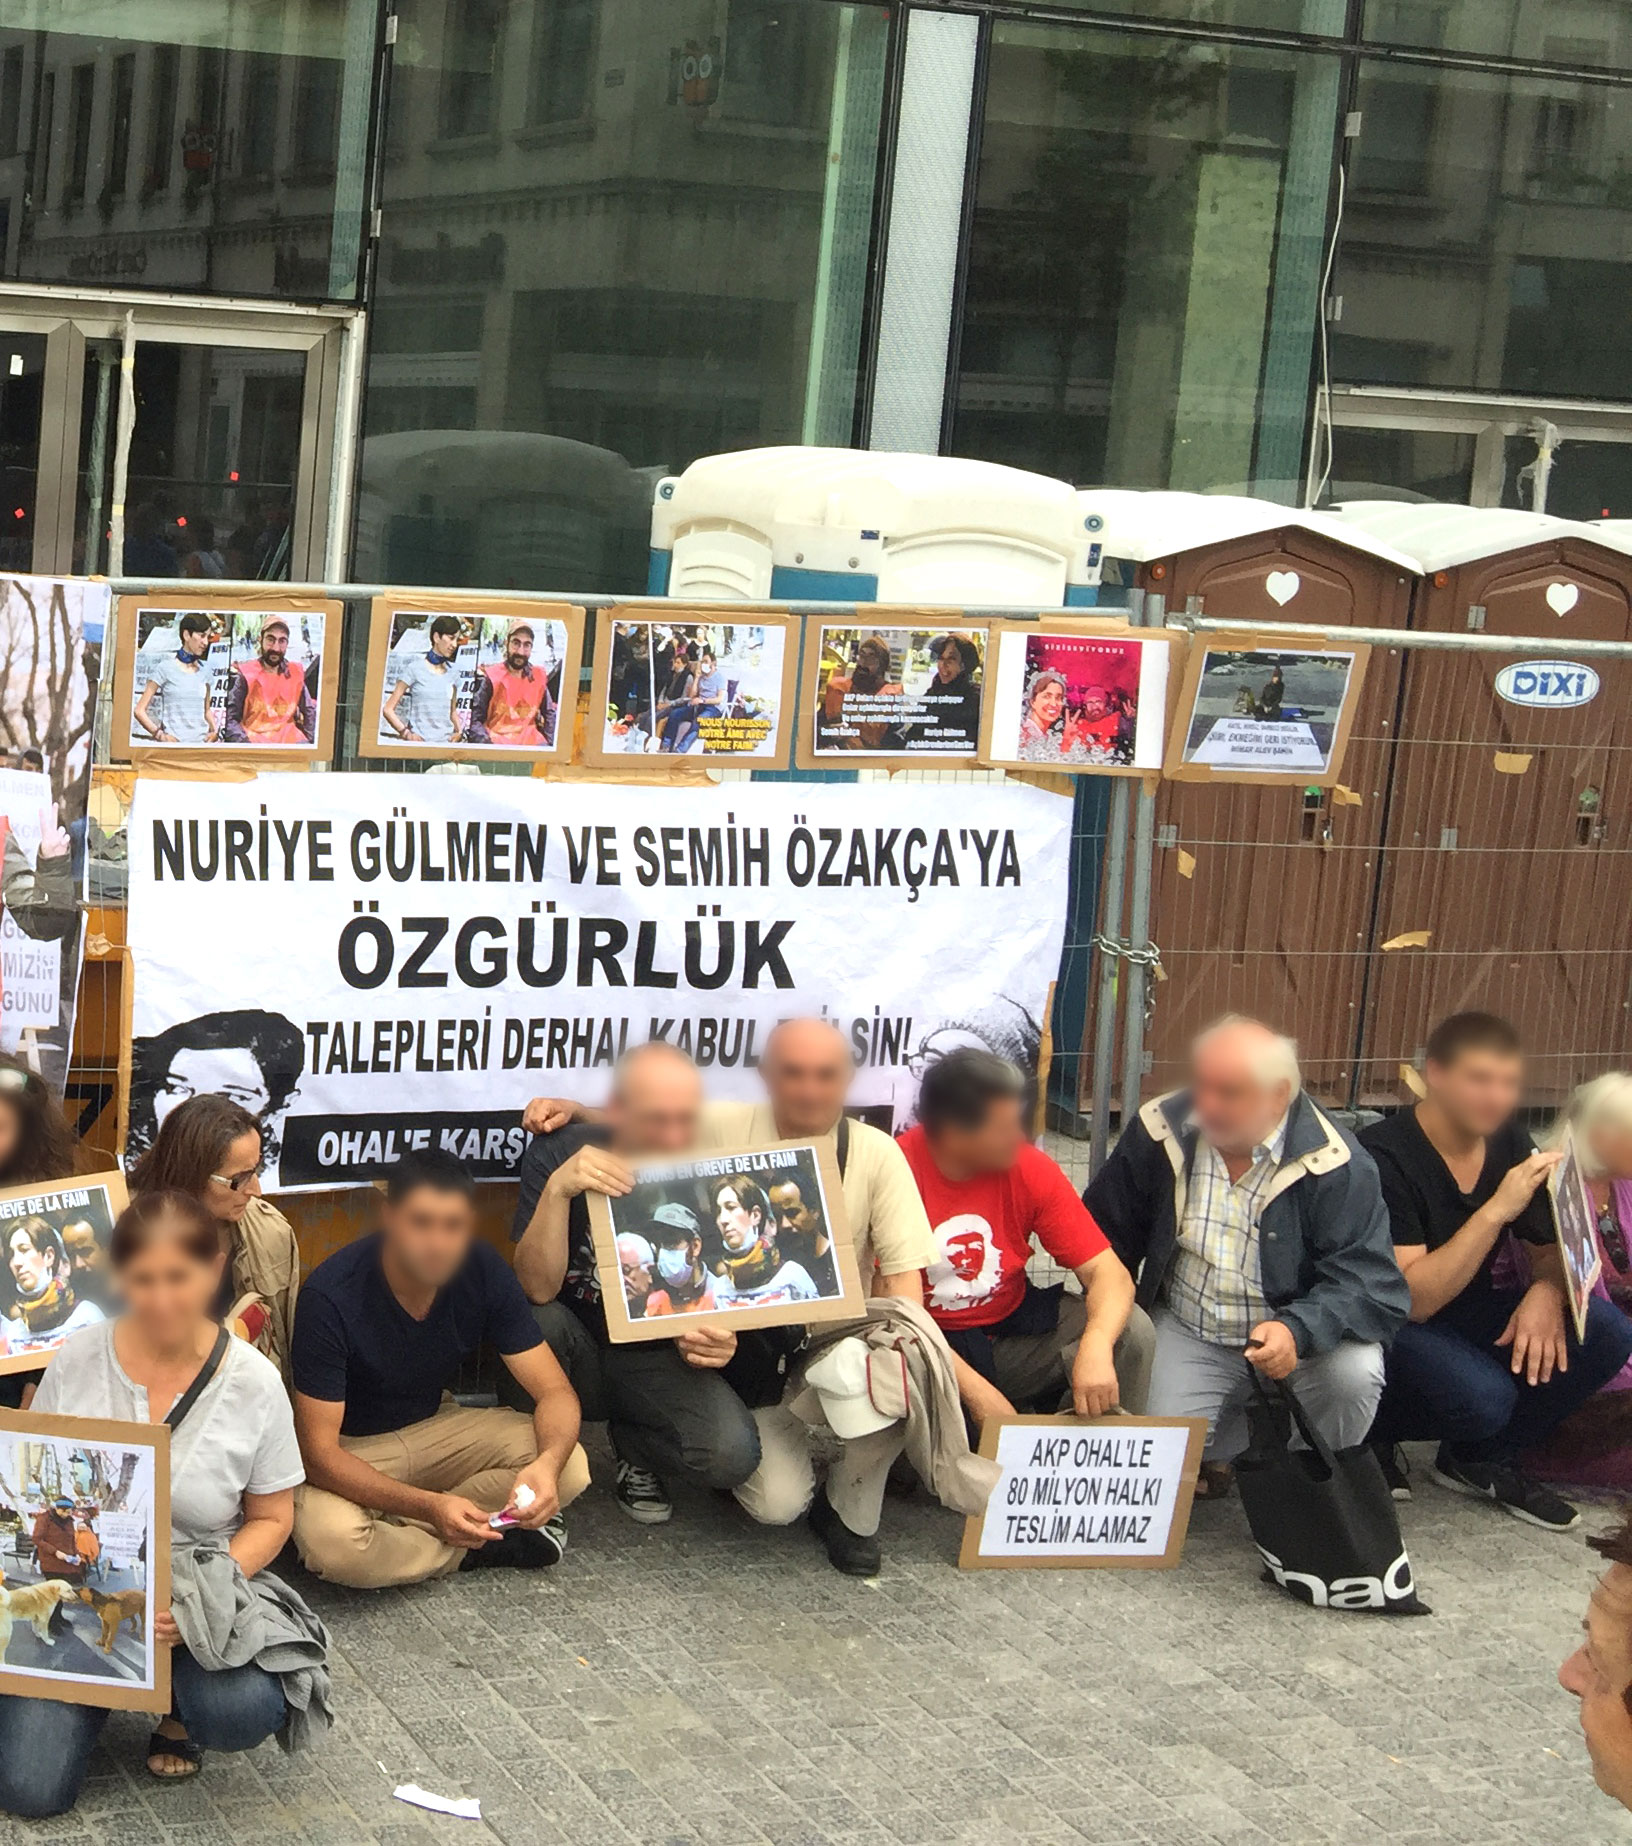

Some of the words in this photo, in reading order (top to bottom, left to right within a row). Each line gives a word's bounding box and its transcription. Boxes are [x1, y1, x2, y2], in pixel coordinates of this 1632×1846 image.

[153, 804, 335, 882] NURİYE
[350, 807, 547, 883] GÜLMEN
[562, 825, 621, 886] VE
[633, 812, 769, 887] SEMİH
[786, 814, 1021, 902] ÖZAKÇA'YA
[337, 900, 796, 989] ÖZGÜRLÜK
[306, 1005, 492, 1075] TALEPLERİ
[695, 1158, 734, 1178] GREVE
[735, 1156, 751, 1173] DE
[752, 1154, 769, 1172] LA
[769, 1151, 798, 1169] FAIM
[27, 1198, 44, 1216] DE
[45, 1195, 62, 1214] LA
[62, 1190, 90, 1210] FAIM
[1029, 1438, 1070, 1468] AKP
[1073, 1438, 1154, 1469] OHAL'LE
[1007, 1476, 1029, 1505] 80
[1032, 1468, 1102, 1506] MİLYON
[1105, 1477, 1162, 1506] HALKI
[1005, 1508, 1071, 1544] TESLİM
[1072, 1515, 1152, 1544] ALAMAZ
